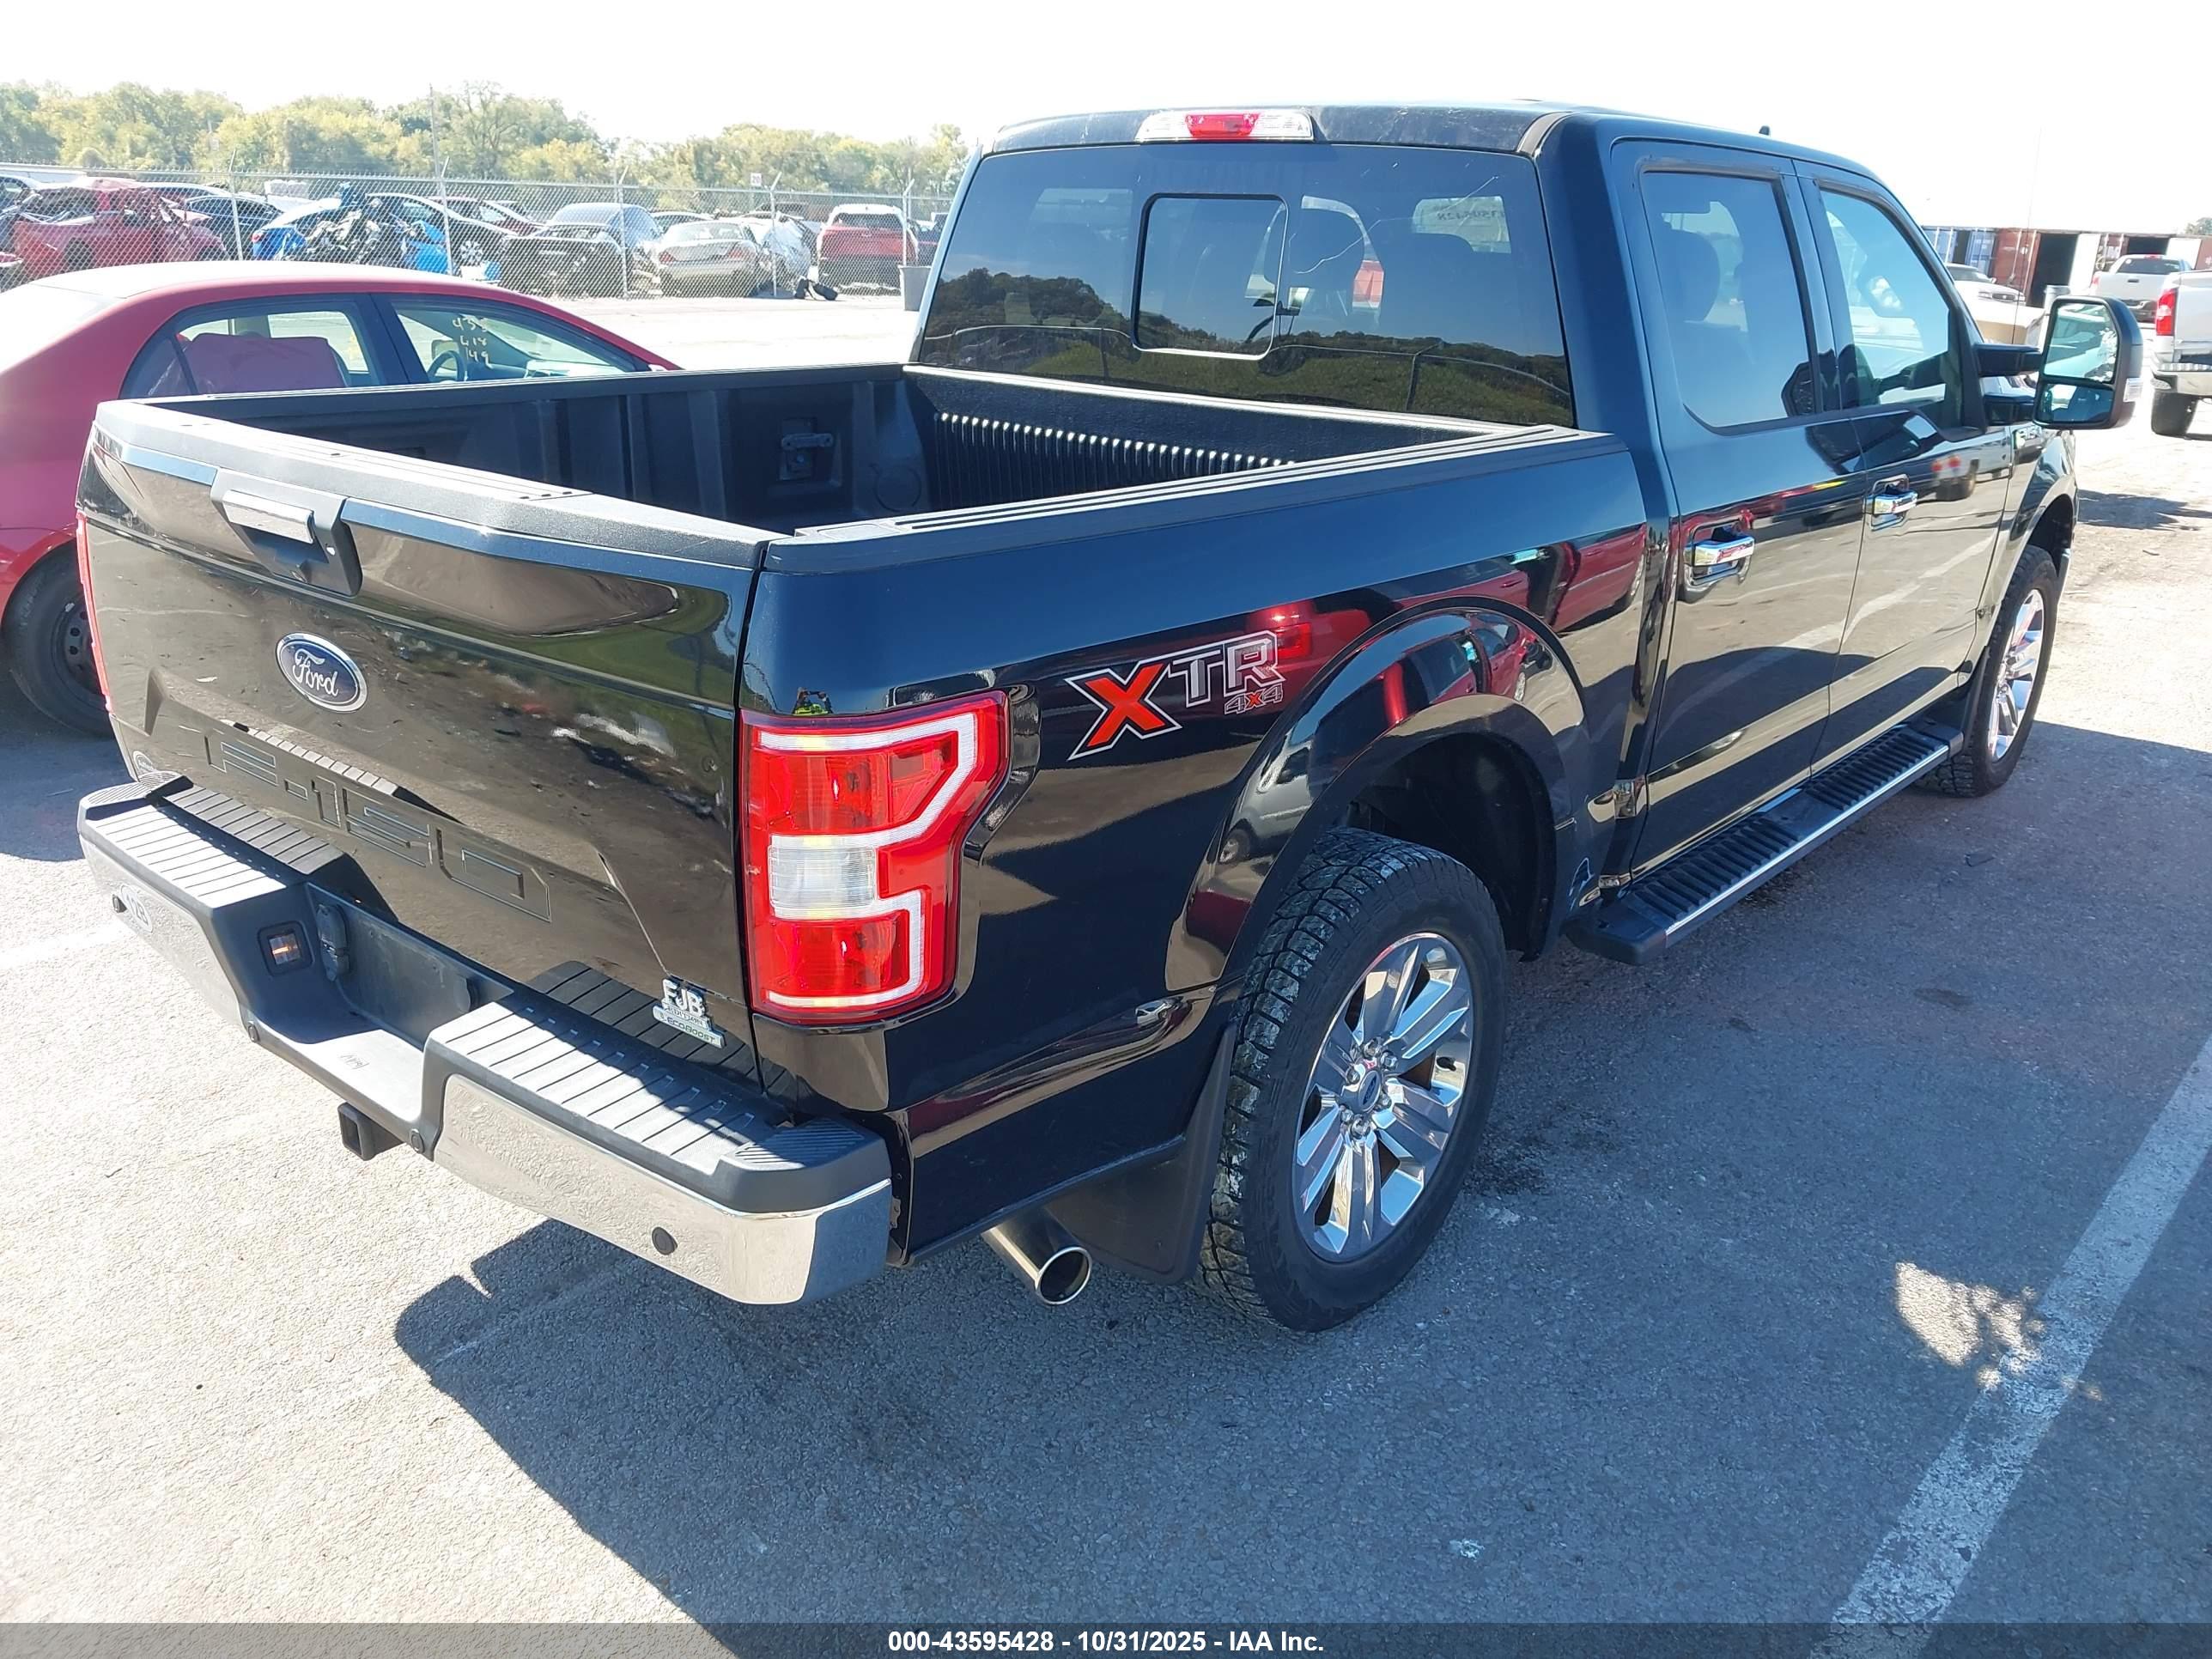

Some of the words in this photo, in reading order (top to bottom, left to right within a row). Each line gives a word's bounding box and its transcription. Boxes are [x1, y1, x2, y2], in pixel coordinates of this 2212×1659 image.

[293, 648, 339, 696] Ford
[204, 726, 551, 922] F-150
[663, 979, 706, 1018] FJB
